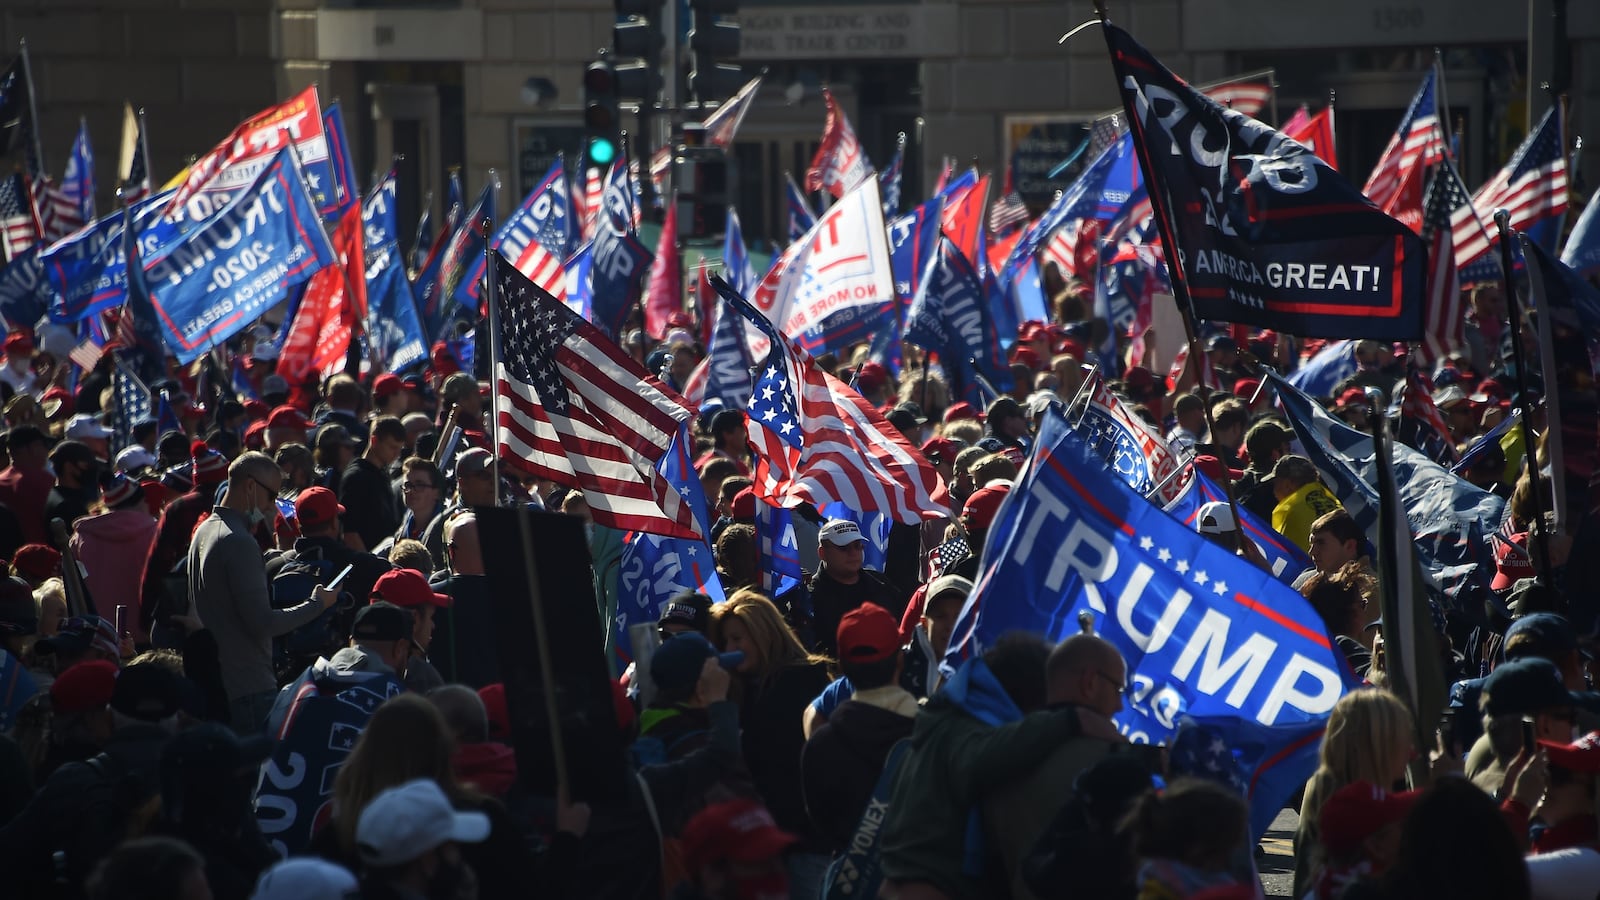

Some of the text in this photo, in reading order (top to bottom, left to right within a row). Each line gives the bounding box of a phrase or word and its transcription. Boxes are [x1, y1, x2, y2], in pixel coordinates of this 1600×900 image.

[791, 14, 866, 31] BUILDING
[873, 13, 911, 29] AND
[785, 34, 838, 51] TRADE
[845, 33, 908, 50] CENTER
[1266, 263, 1381, 292] GREAT!
[1013, 480, 1342, 727] TRUMP
[849, 797, 889, 857] YONEX
